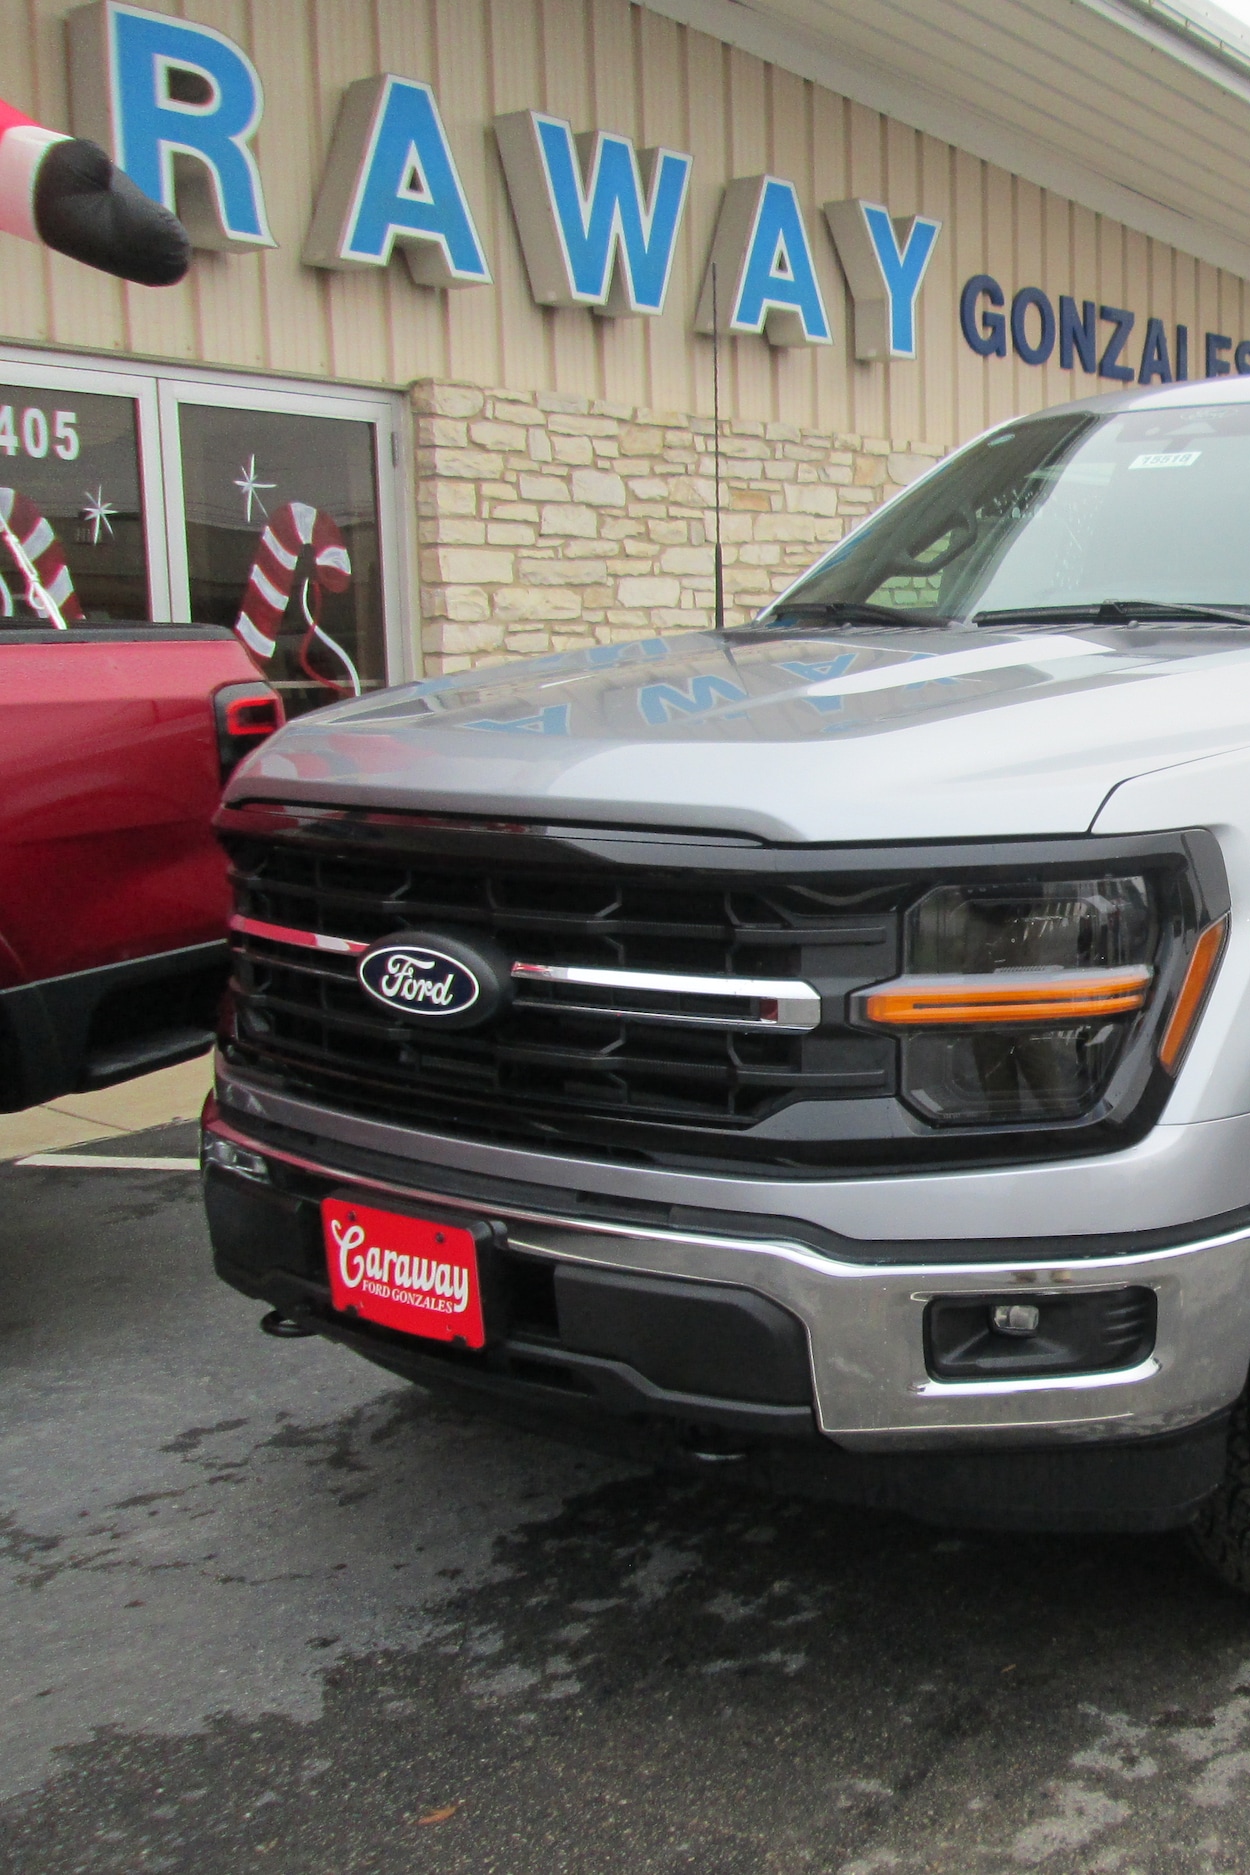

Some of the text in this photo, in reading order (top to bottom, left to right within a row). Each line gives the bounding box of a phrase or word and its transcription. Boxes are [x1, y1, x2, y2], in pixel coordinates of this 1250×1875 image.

[100, 1, 943, 360] RAWAY
[382, 954, 455, 1006] Ford
[331, 1219, 469, 1312] Caraway
[362, 1279, 453, 1313] FORD GONZALES
